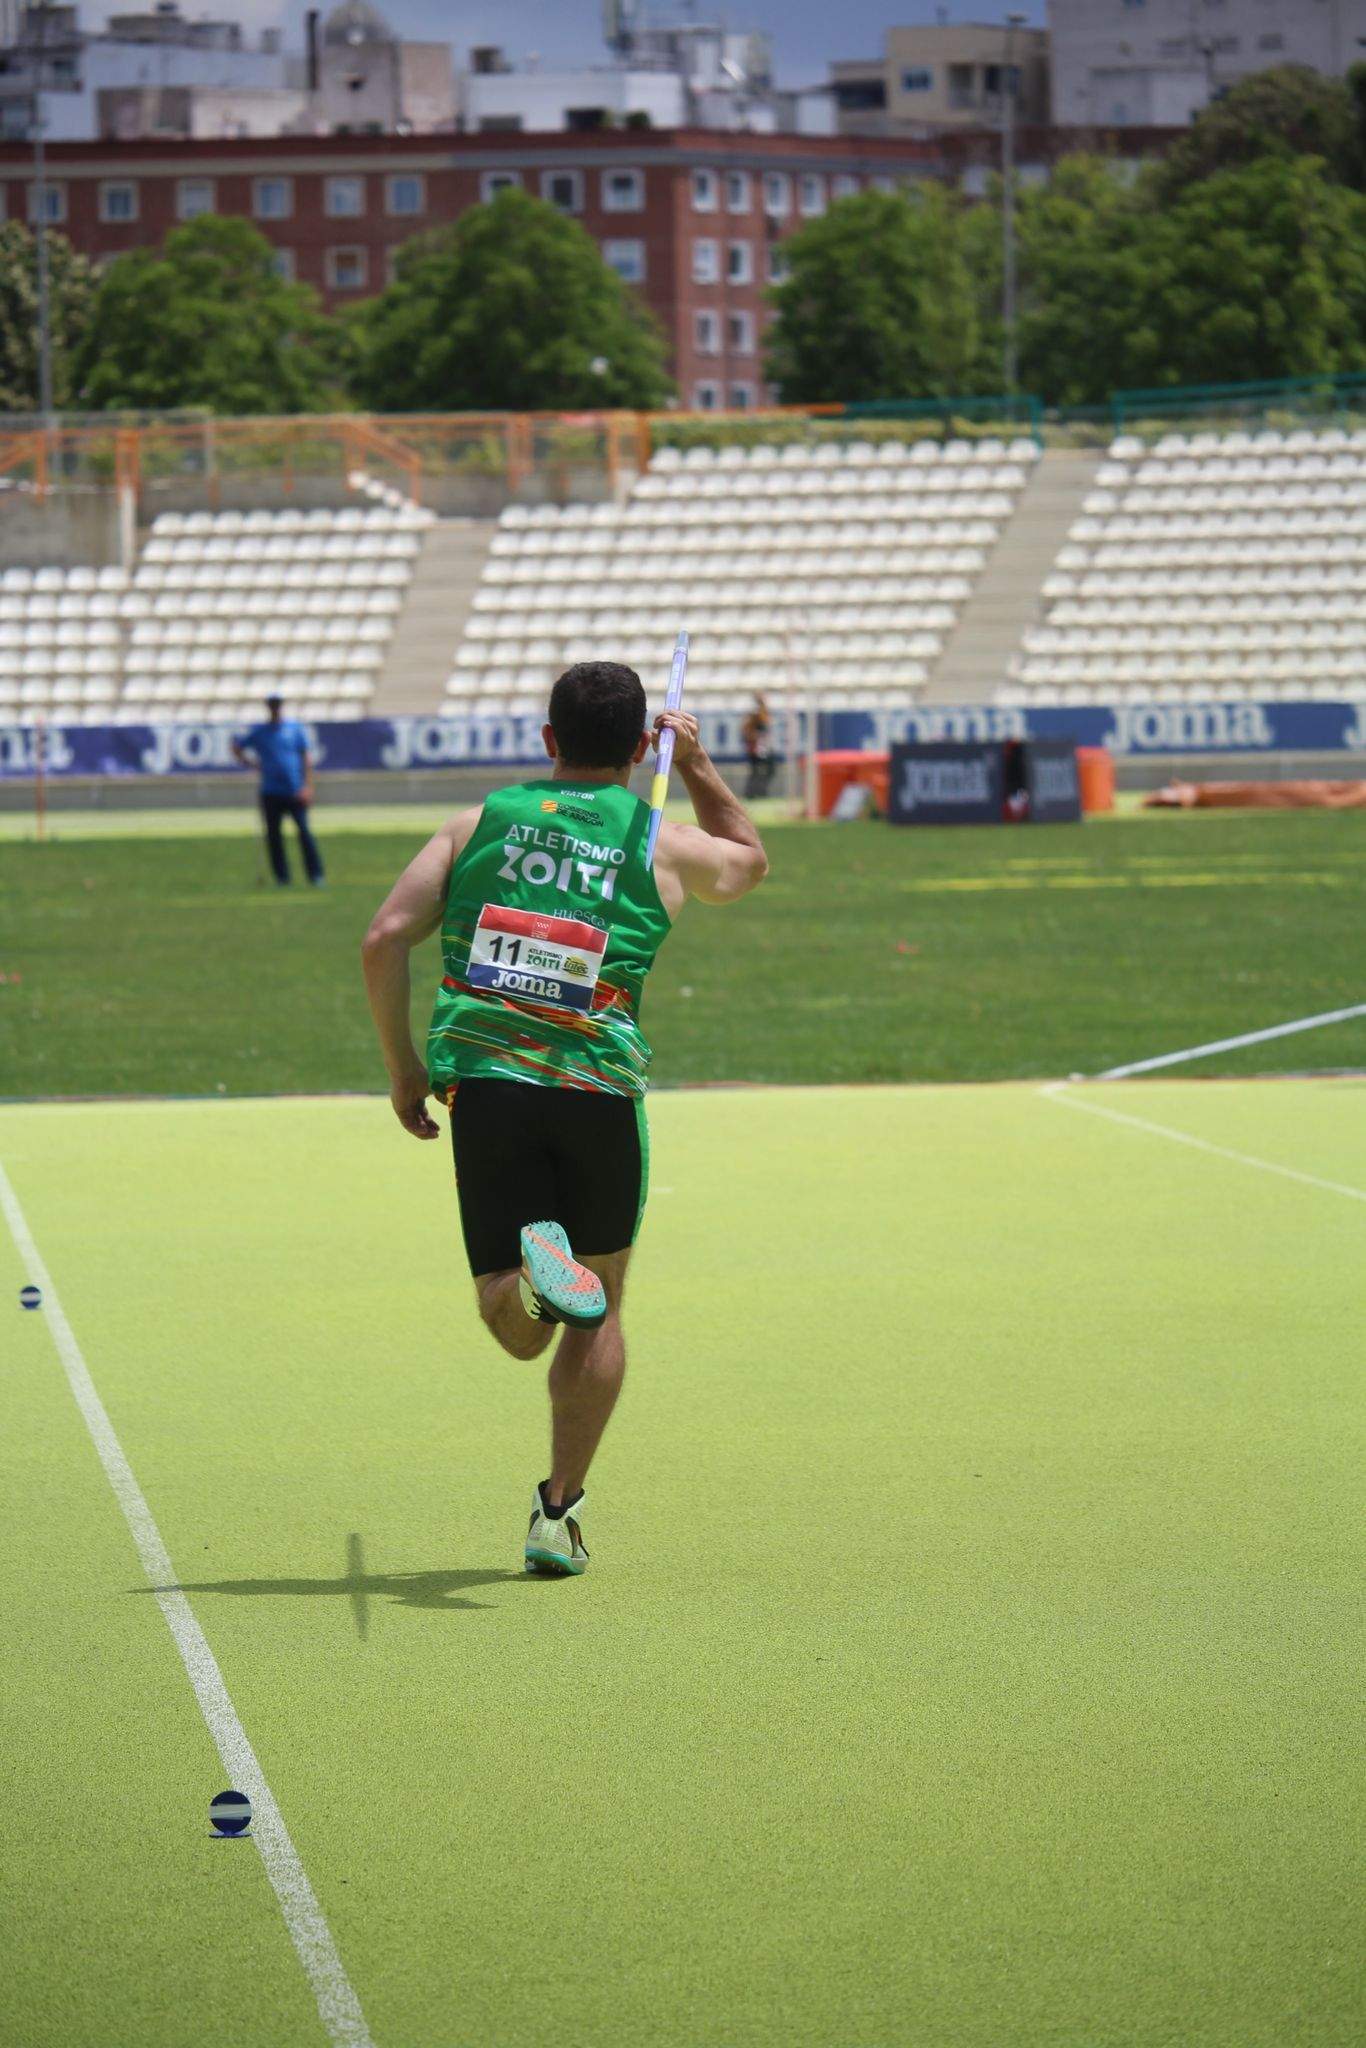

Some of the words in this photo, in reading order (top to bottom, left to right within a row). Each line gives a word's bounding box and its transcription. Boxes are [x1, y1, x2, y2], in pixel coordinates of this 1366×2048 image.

[1102, 703, 1275, 757] Joma
[505, 824, 626, 865] ATLETISMO
[496, 844, 618, 901] ZOITI
[489, 935, 522, 967] 11
[526, 953, 562, 970] ZOITI
[528, 948, 563, 960] ATLETISMO
[491, 970, 563, 999] Joma
